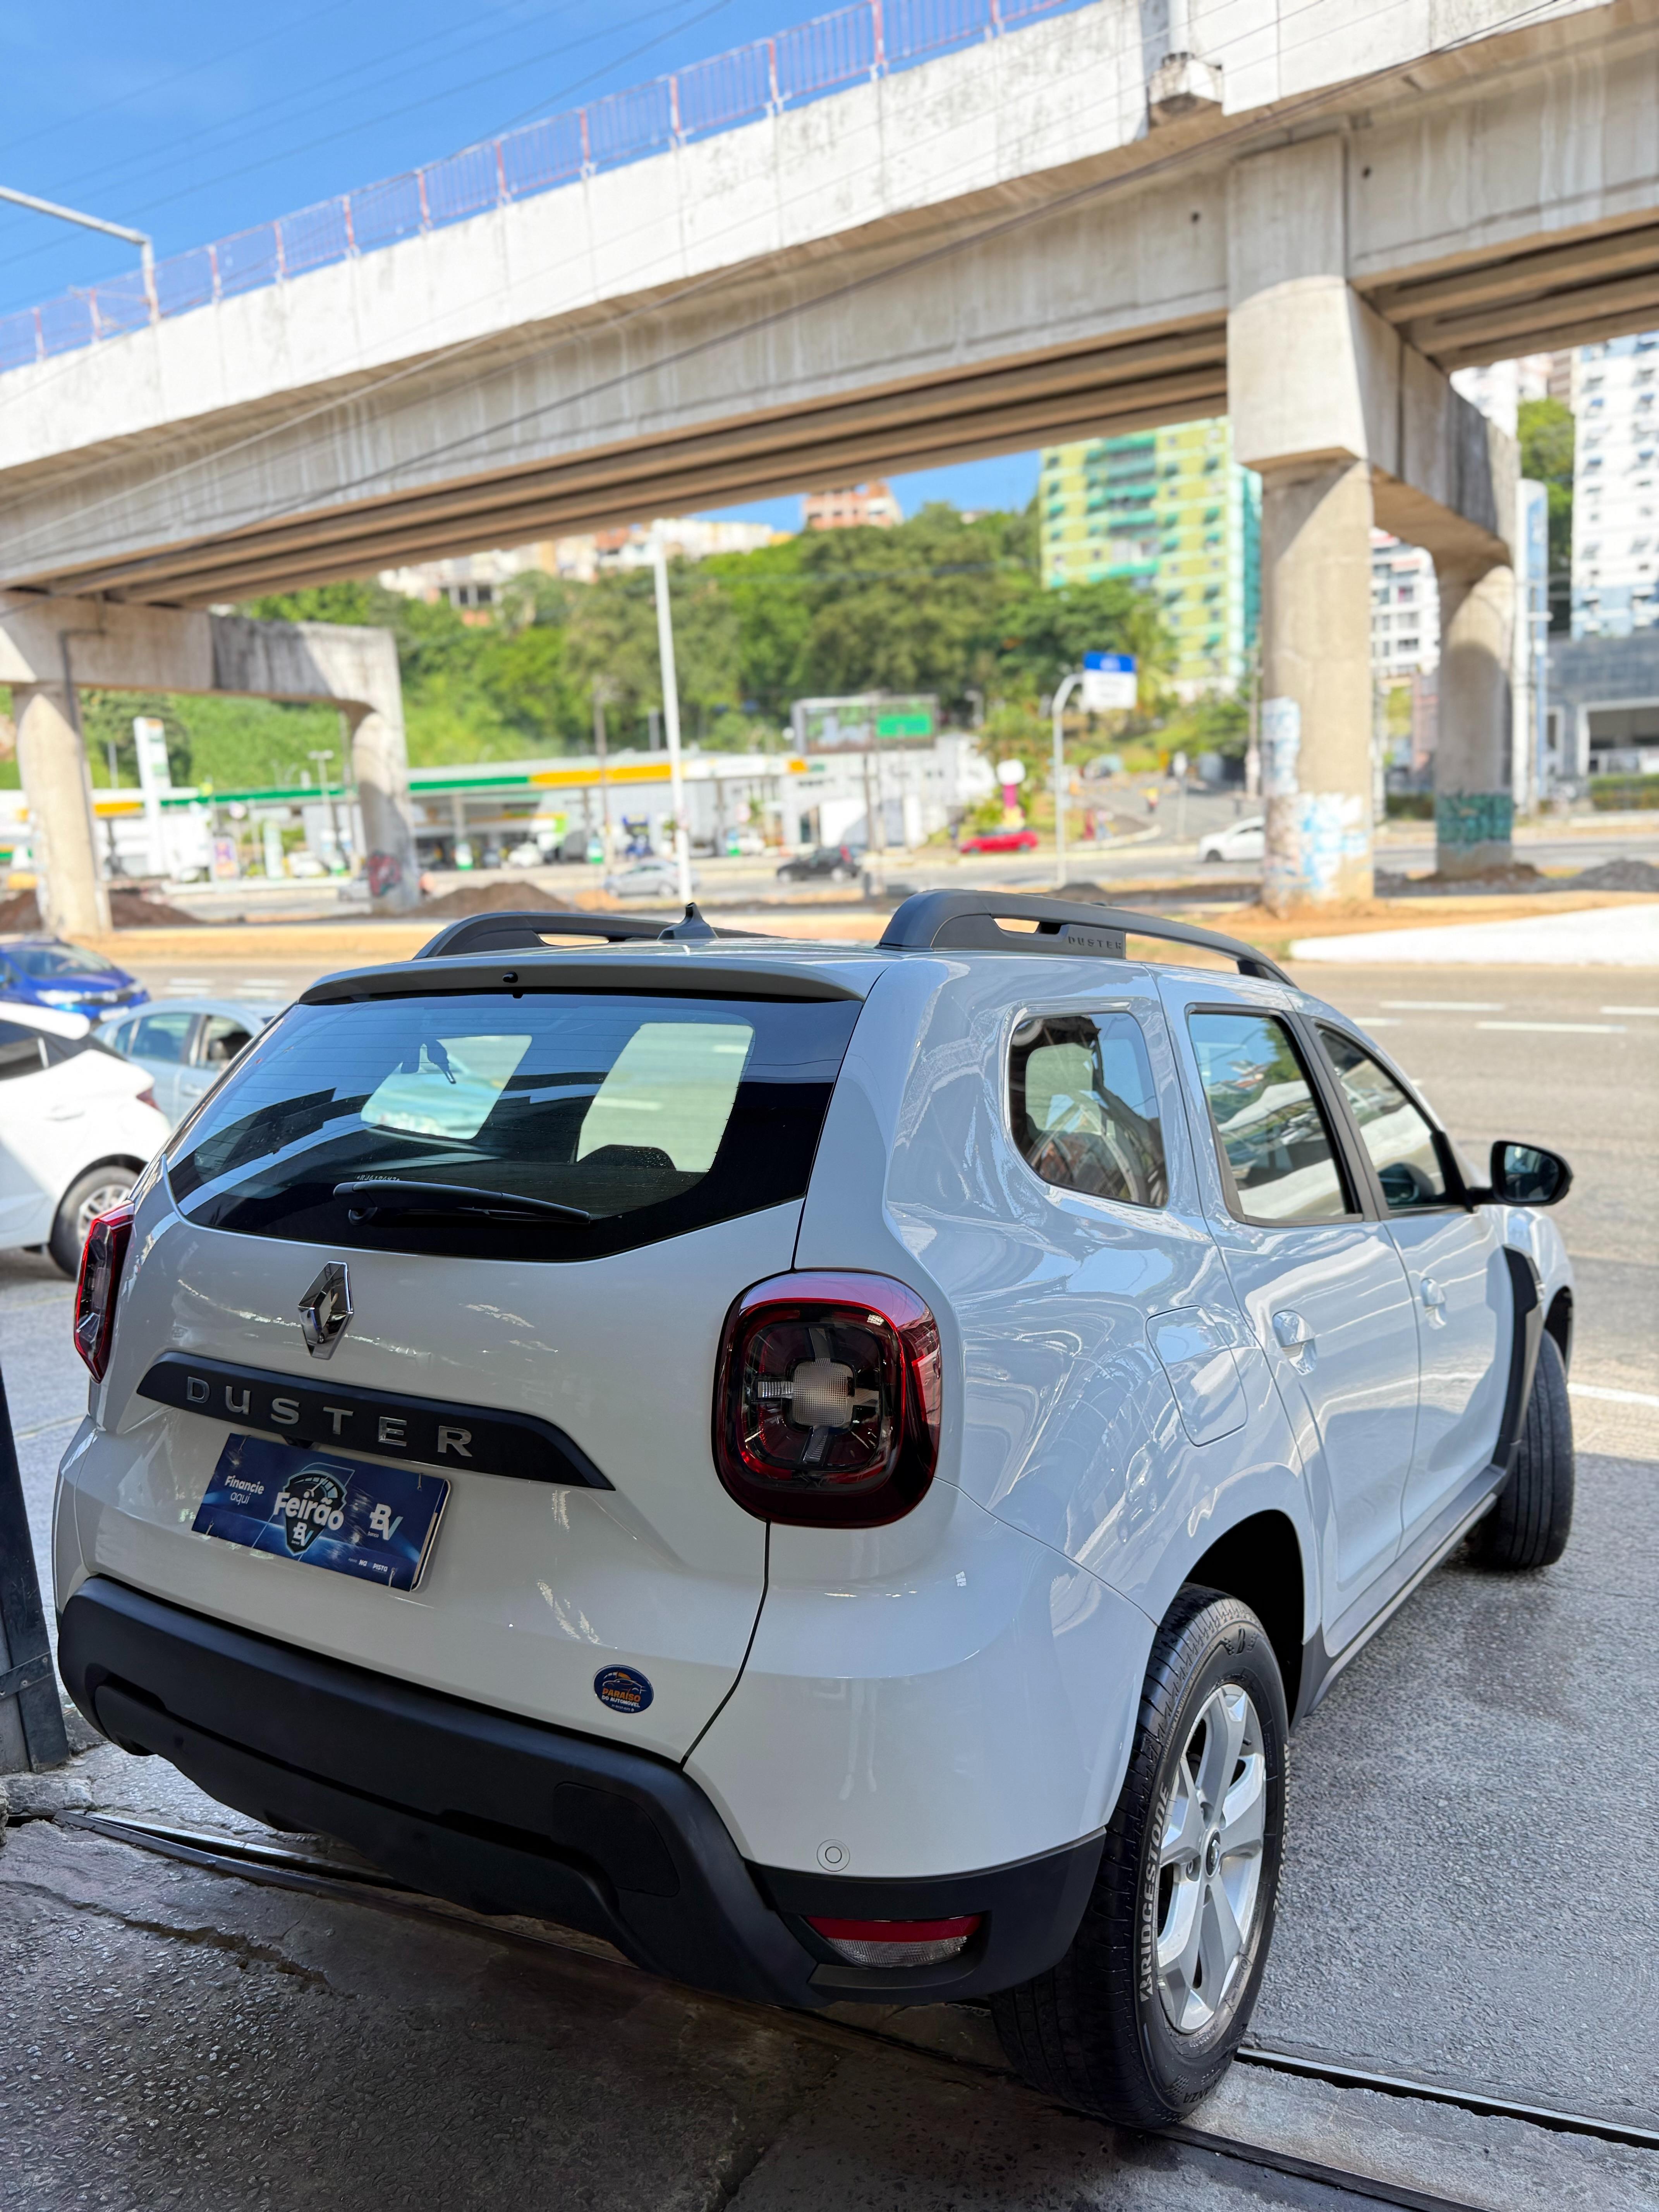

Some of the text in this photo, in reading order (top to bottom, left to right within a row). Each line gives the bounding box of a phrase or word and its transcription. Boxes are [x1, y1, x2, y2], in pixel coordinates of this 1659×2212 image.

[1068, 935, 1122, 950] DUSTER
[186, 1376, 473, 1457] DUSTER
[225, 1475, 264, 1495] Financie
[230, 1492, 251, 1506] aqui
[273, 1491, 344, 1530] Feirão
[602, 1688, 641, 1702] PARAÍSO
[1140, 1781, 1169, 2002] BRIDGESTONE
